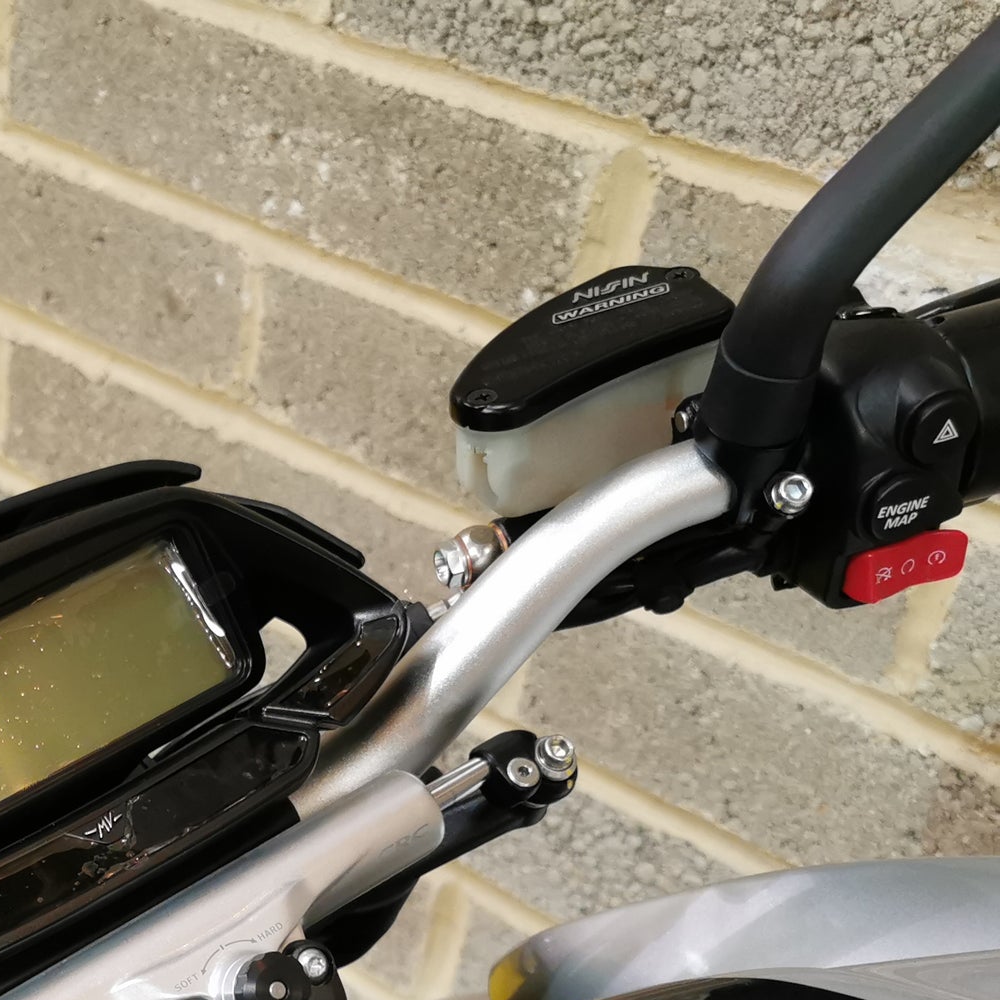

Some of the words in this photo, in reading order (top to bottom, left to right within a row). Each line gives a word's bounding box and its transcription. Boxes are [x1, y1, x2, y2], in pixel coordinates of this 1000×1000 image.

[572, 271, 649, 303] NISSIN
[557, 286, 667, 321] WARNING
[877, 496, 930, 519] ENGINE
[884, 512, 918, 530] MAP
[257, 922, 283, 942] HARD
[174, 974, 199, 992] SOFT
